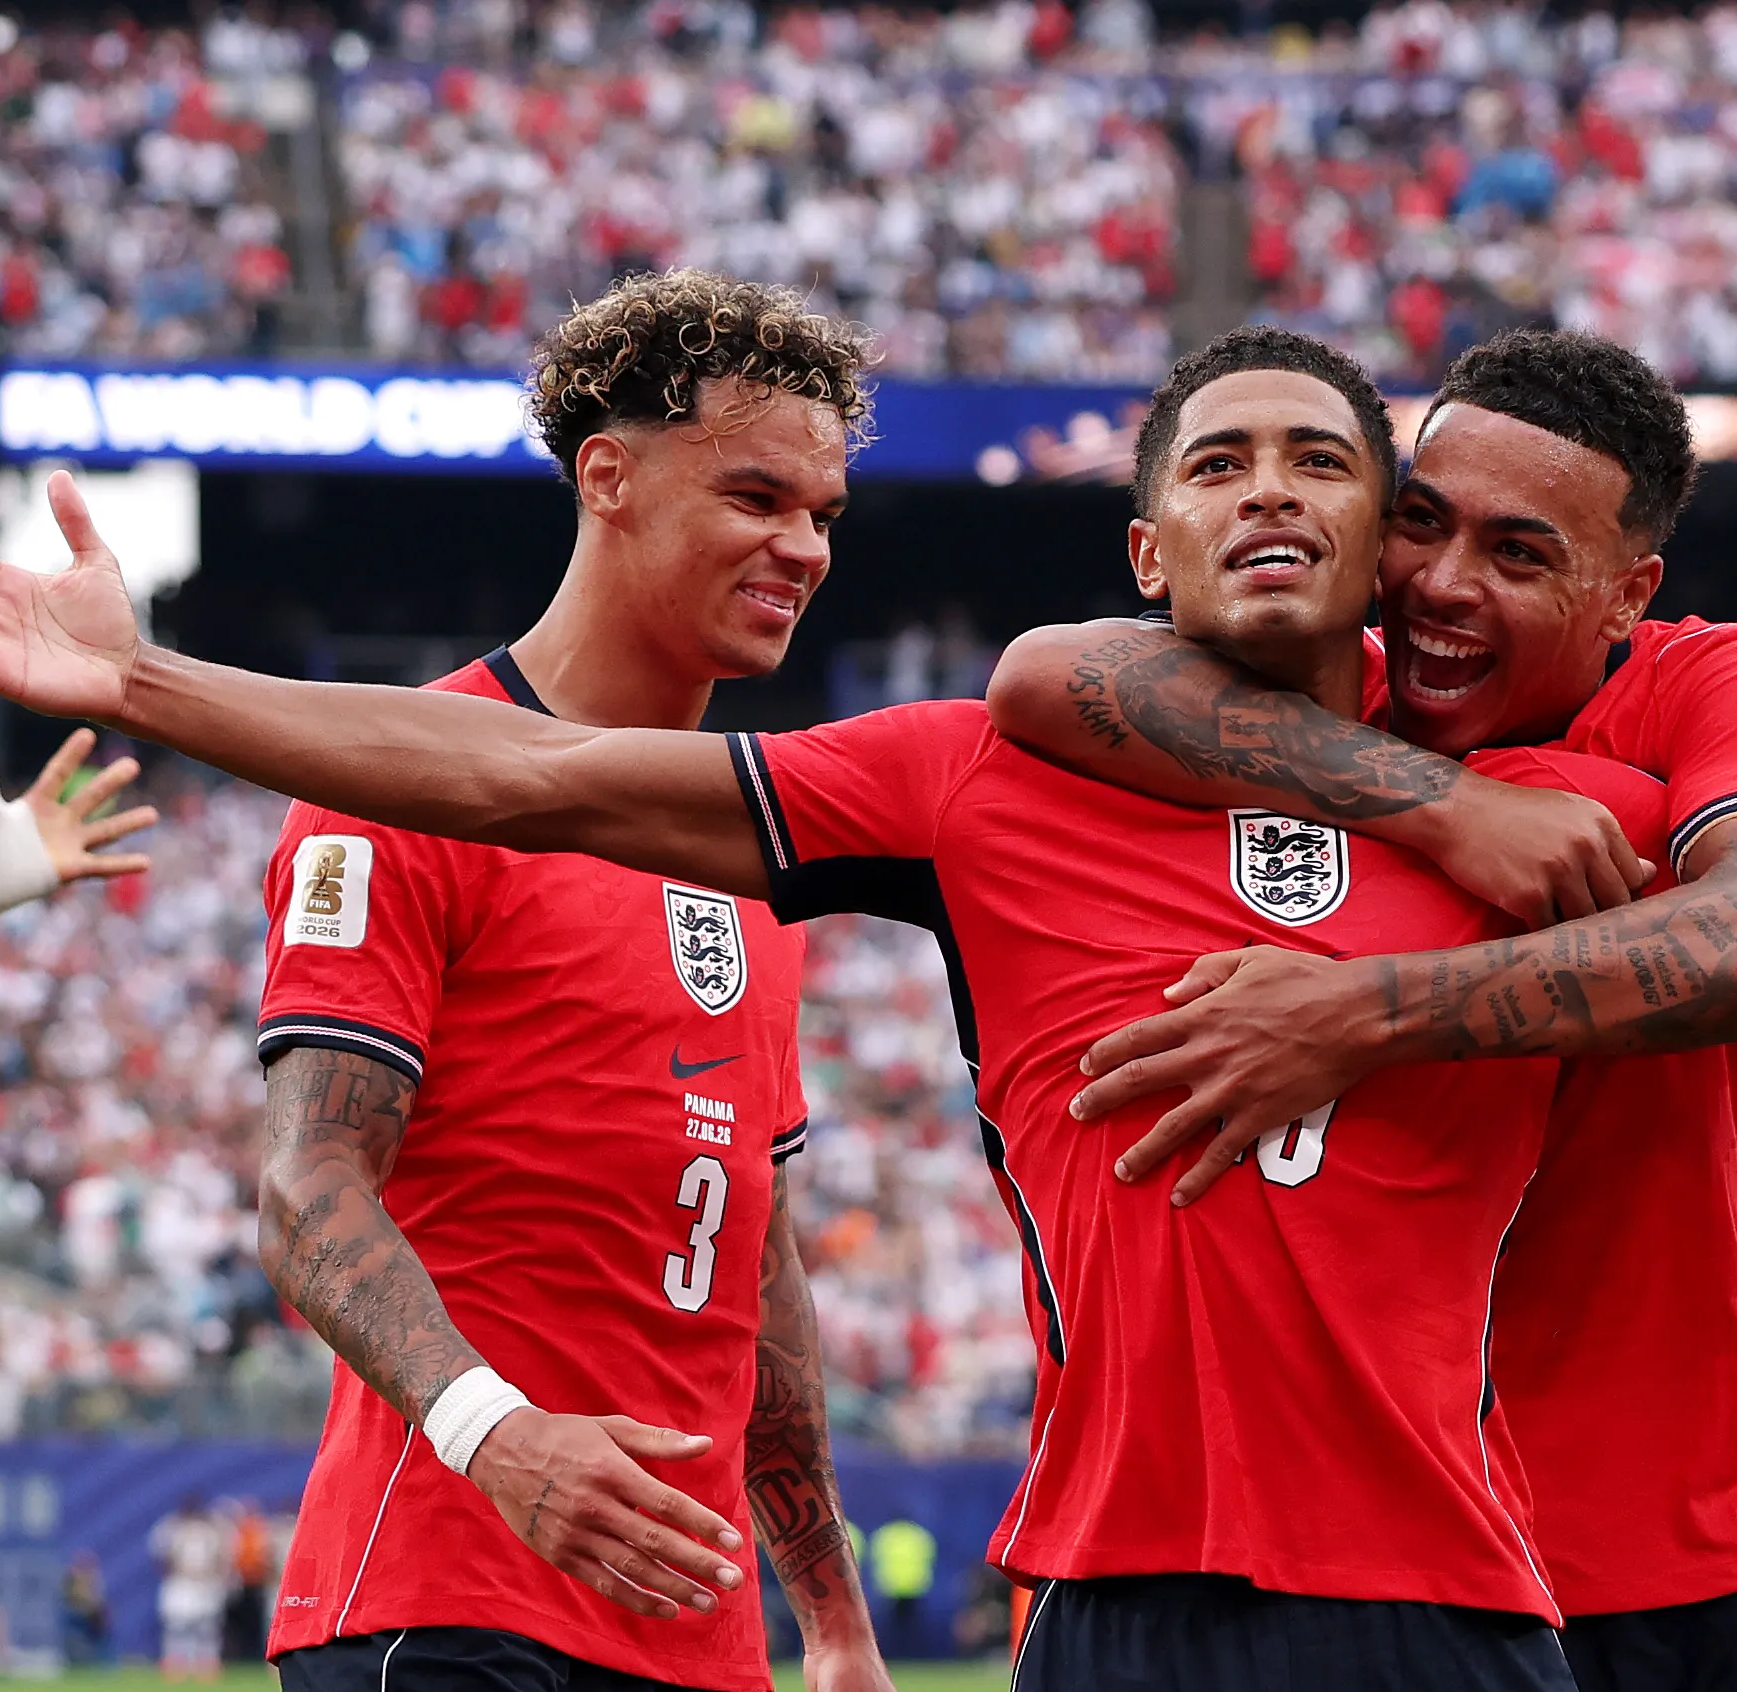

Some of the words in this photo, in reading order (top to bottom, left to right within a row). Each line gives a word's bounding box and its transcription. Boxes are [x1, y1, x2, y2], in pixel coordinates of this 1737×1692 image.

[94, 372, 376, 457] WORLD
[309, 898, 331, 910] FIFA
[296, 925, 341, 938] 2026
[684, 1091, 736, 1123] PANAMA
[685, 1117, 732, 1146] 27.06.26
[663, 1155, 729, 1314] 3
